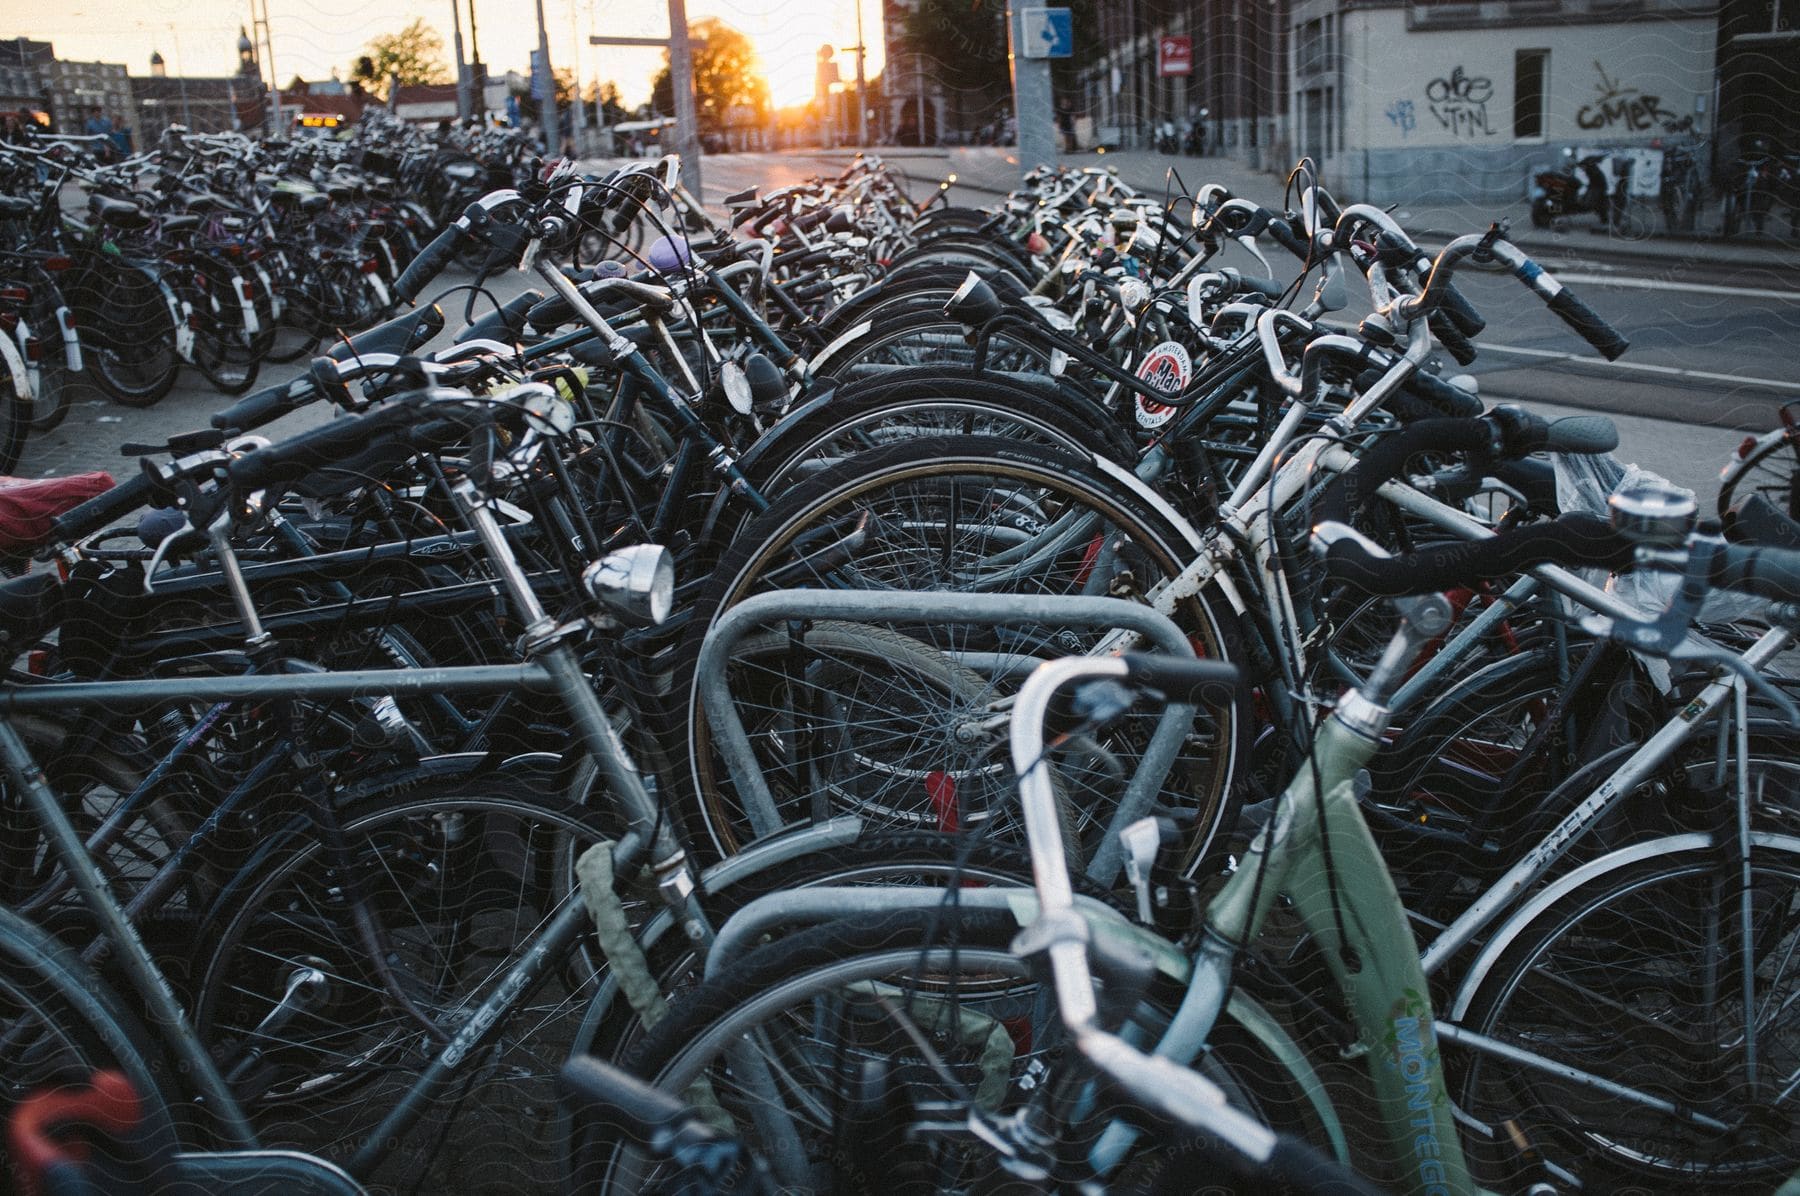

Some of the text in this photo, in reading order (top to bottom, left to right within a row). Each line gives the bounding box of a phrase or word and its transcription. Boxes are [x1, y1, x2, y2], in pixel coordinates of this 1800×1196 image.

[1157, 344, 1189, 373] AMSTERDAM
[1157, 358, 1181, 392] Mac
[1137, 413, 1163, 426] RENTALS
[1523, 782, 1619, 869] GAZELLE
[441, 967, 531, 1069] GAZELLE
